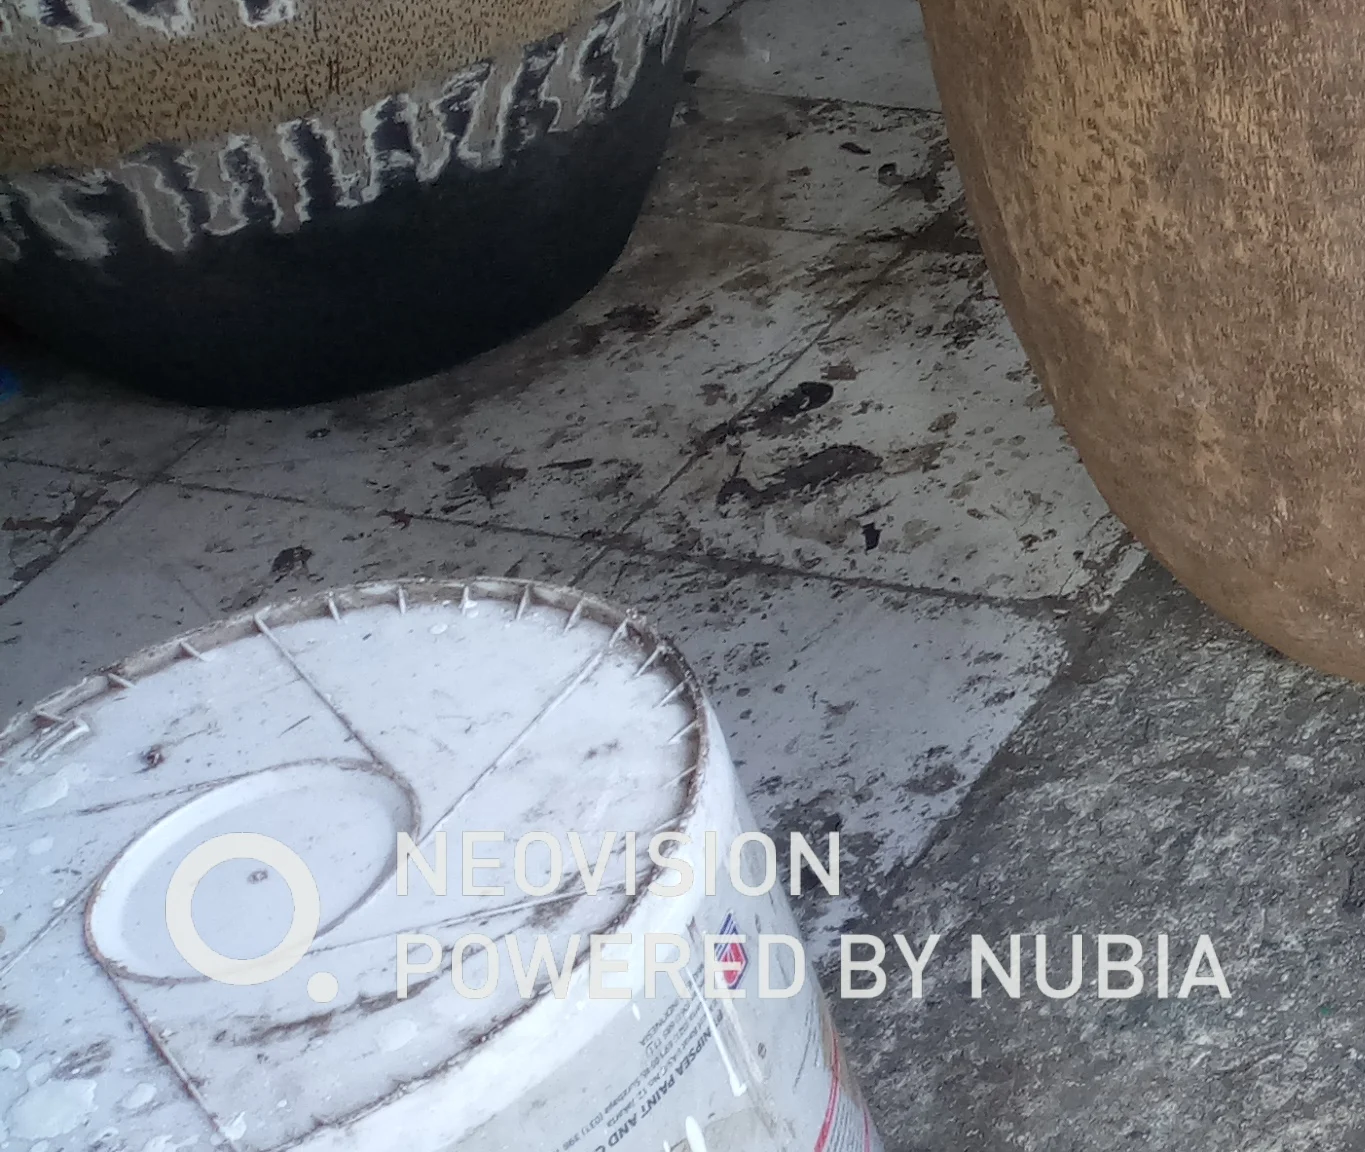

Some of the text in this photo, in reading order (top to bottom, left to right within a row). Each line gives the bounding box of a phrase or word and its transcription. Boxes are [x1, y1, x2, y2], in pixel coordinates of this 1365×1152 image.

[675, 1027, 712, 1076] NIPSEA
[641, 1074, 675, 1119] PAINT
[607, 1113, 636, 1147] AND
